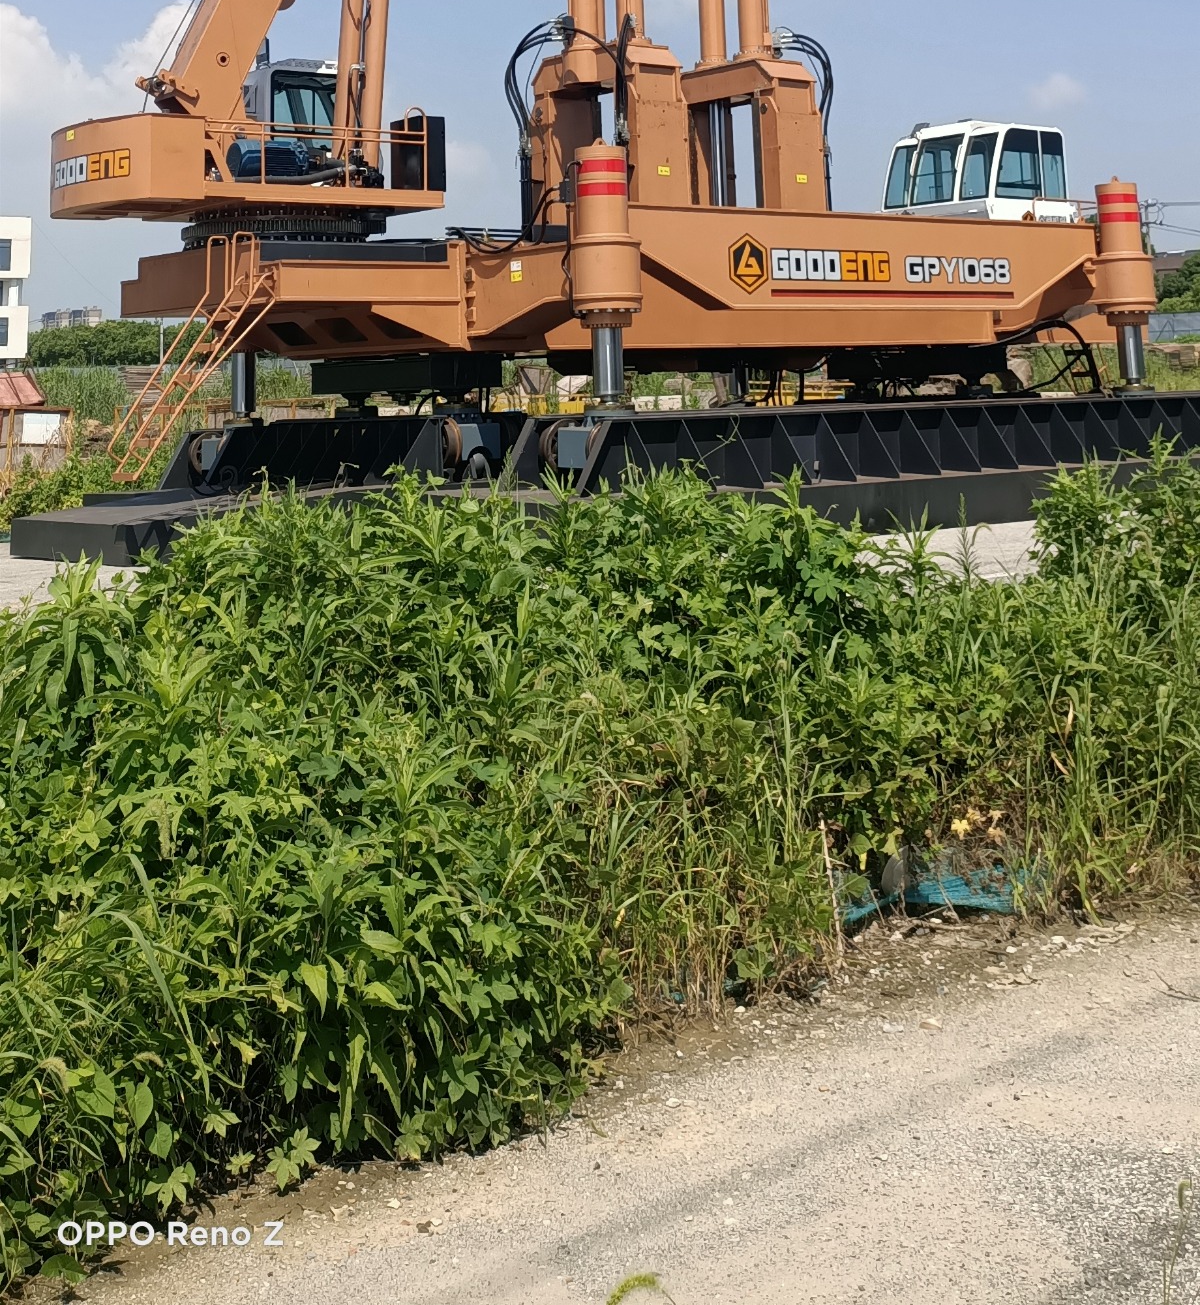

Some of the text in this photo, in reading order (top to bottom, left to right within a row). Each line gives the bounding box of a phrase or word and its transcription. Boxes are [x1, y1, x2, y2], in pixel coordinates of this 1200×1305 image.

[54, 148, 130, 190] GOODENG
[770, 248, 1012, 284] GOODENG GPY1068
